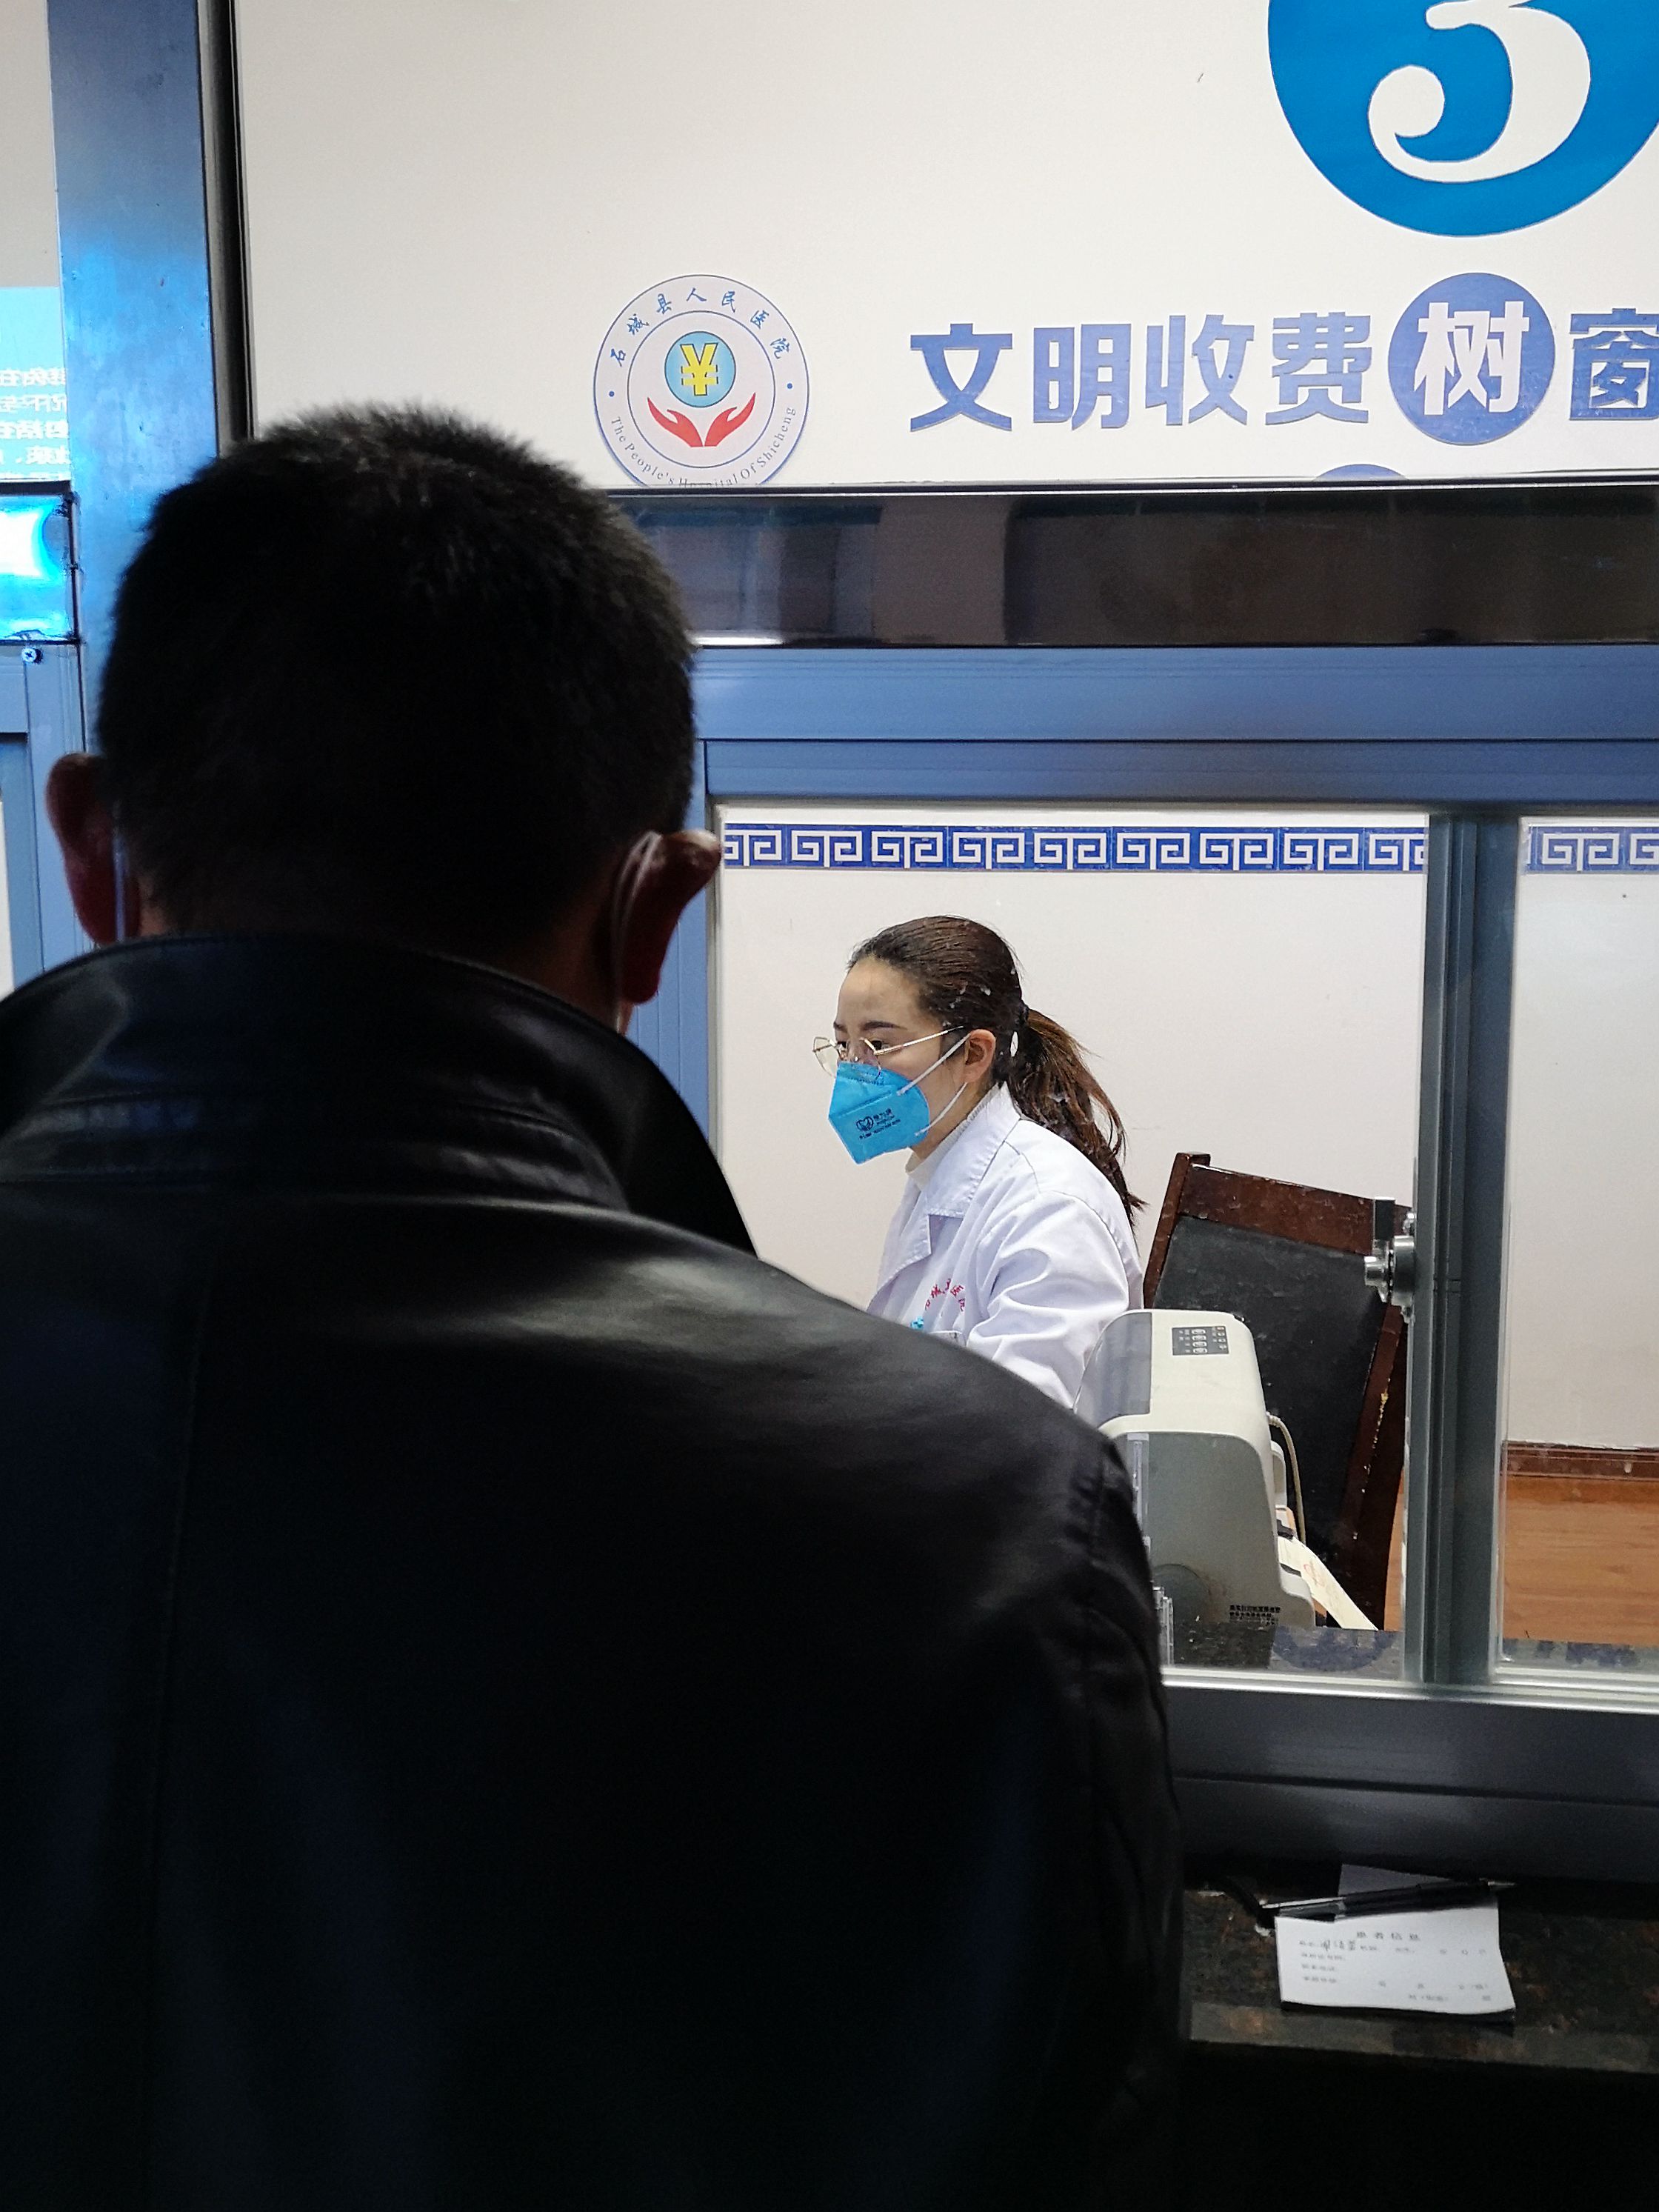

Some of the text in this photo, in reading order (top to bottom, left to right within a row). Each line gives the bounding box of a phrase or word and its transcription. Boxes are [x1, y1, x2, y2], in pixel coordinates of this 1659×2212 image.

[1368, 0, 1591, 183] 3
[610, 287, 790, 367] 石城县人民医院
[611, 416, 626, 442] The
[625, 443, 674, 485] People's
[757, 407, 796, 467] Shicheng
